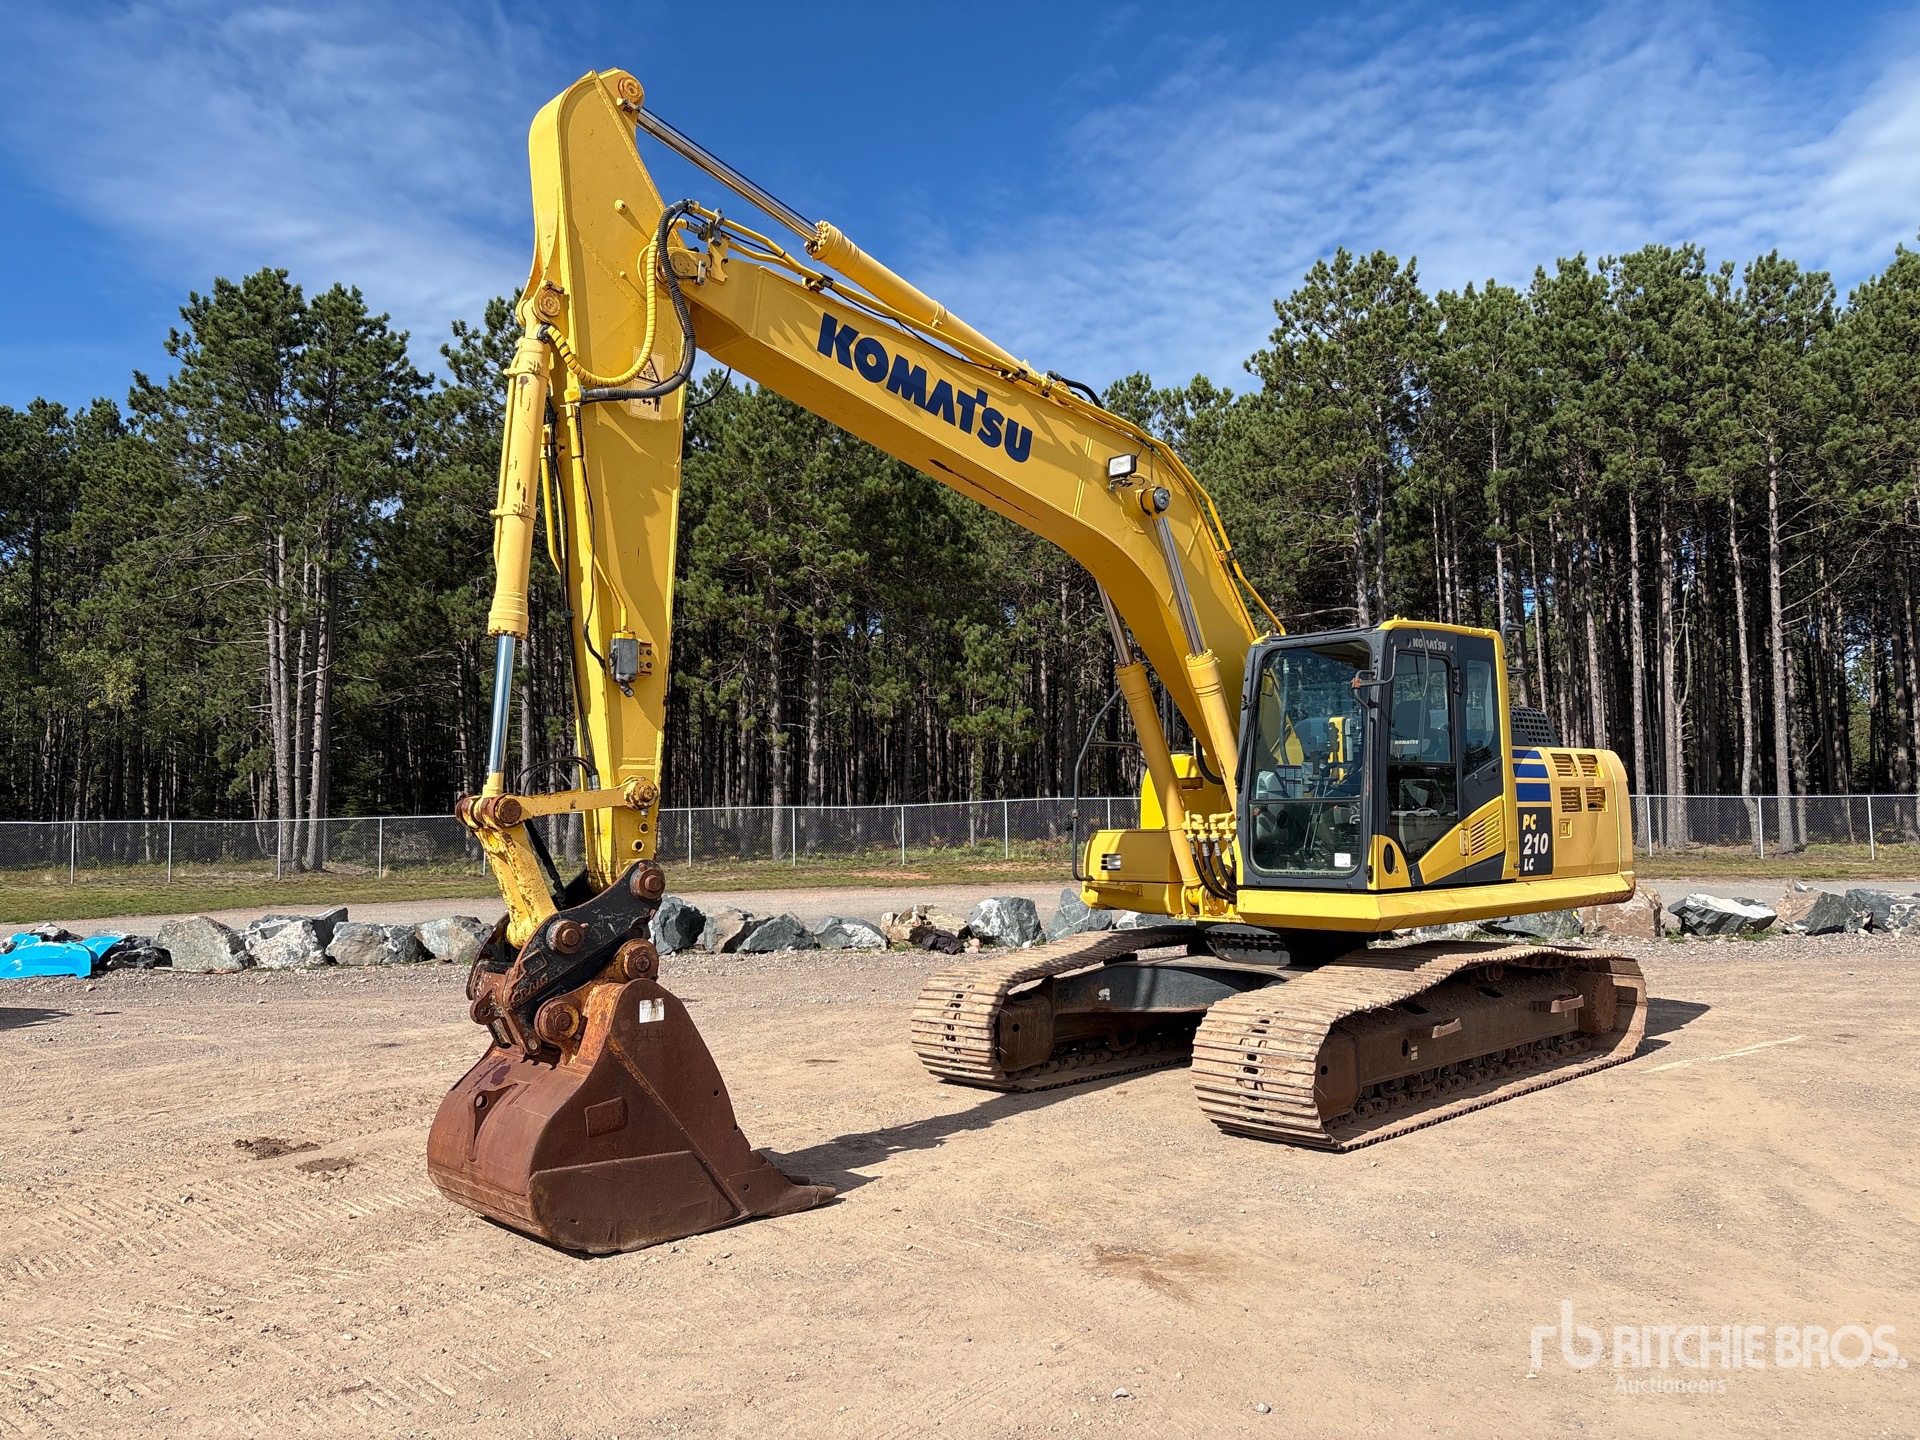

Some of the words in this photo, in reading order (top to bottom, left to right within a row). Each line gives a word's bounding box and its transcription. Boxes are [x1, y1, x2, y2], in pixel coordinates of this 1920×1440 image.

[817, 312, 1033, 463] KOMATSU
[1412, 638, 1447, 651] KOMATSU
[1522, 813, 1537, 831] PC
[1522, 832, 1549, 855] 210
[1523, 857, 1535, 872] LC
